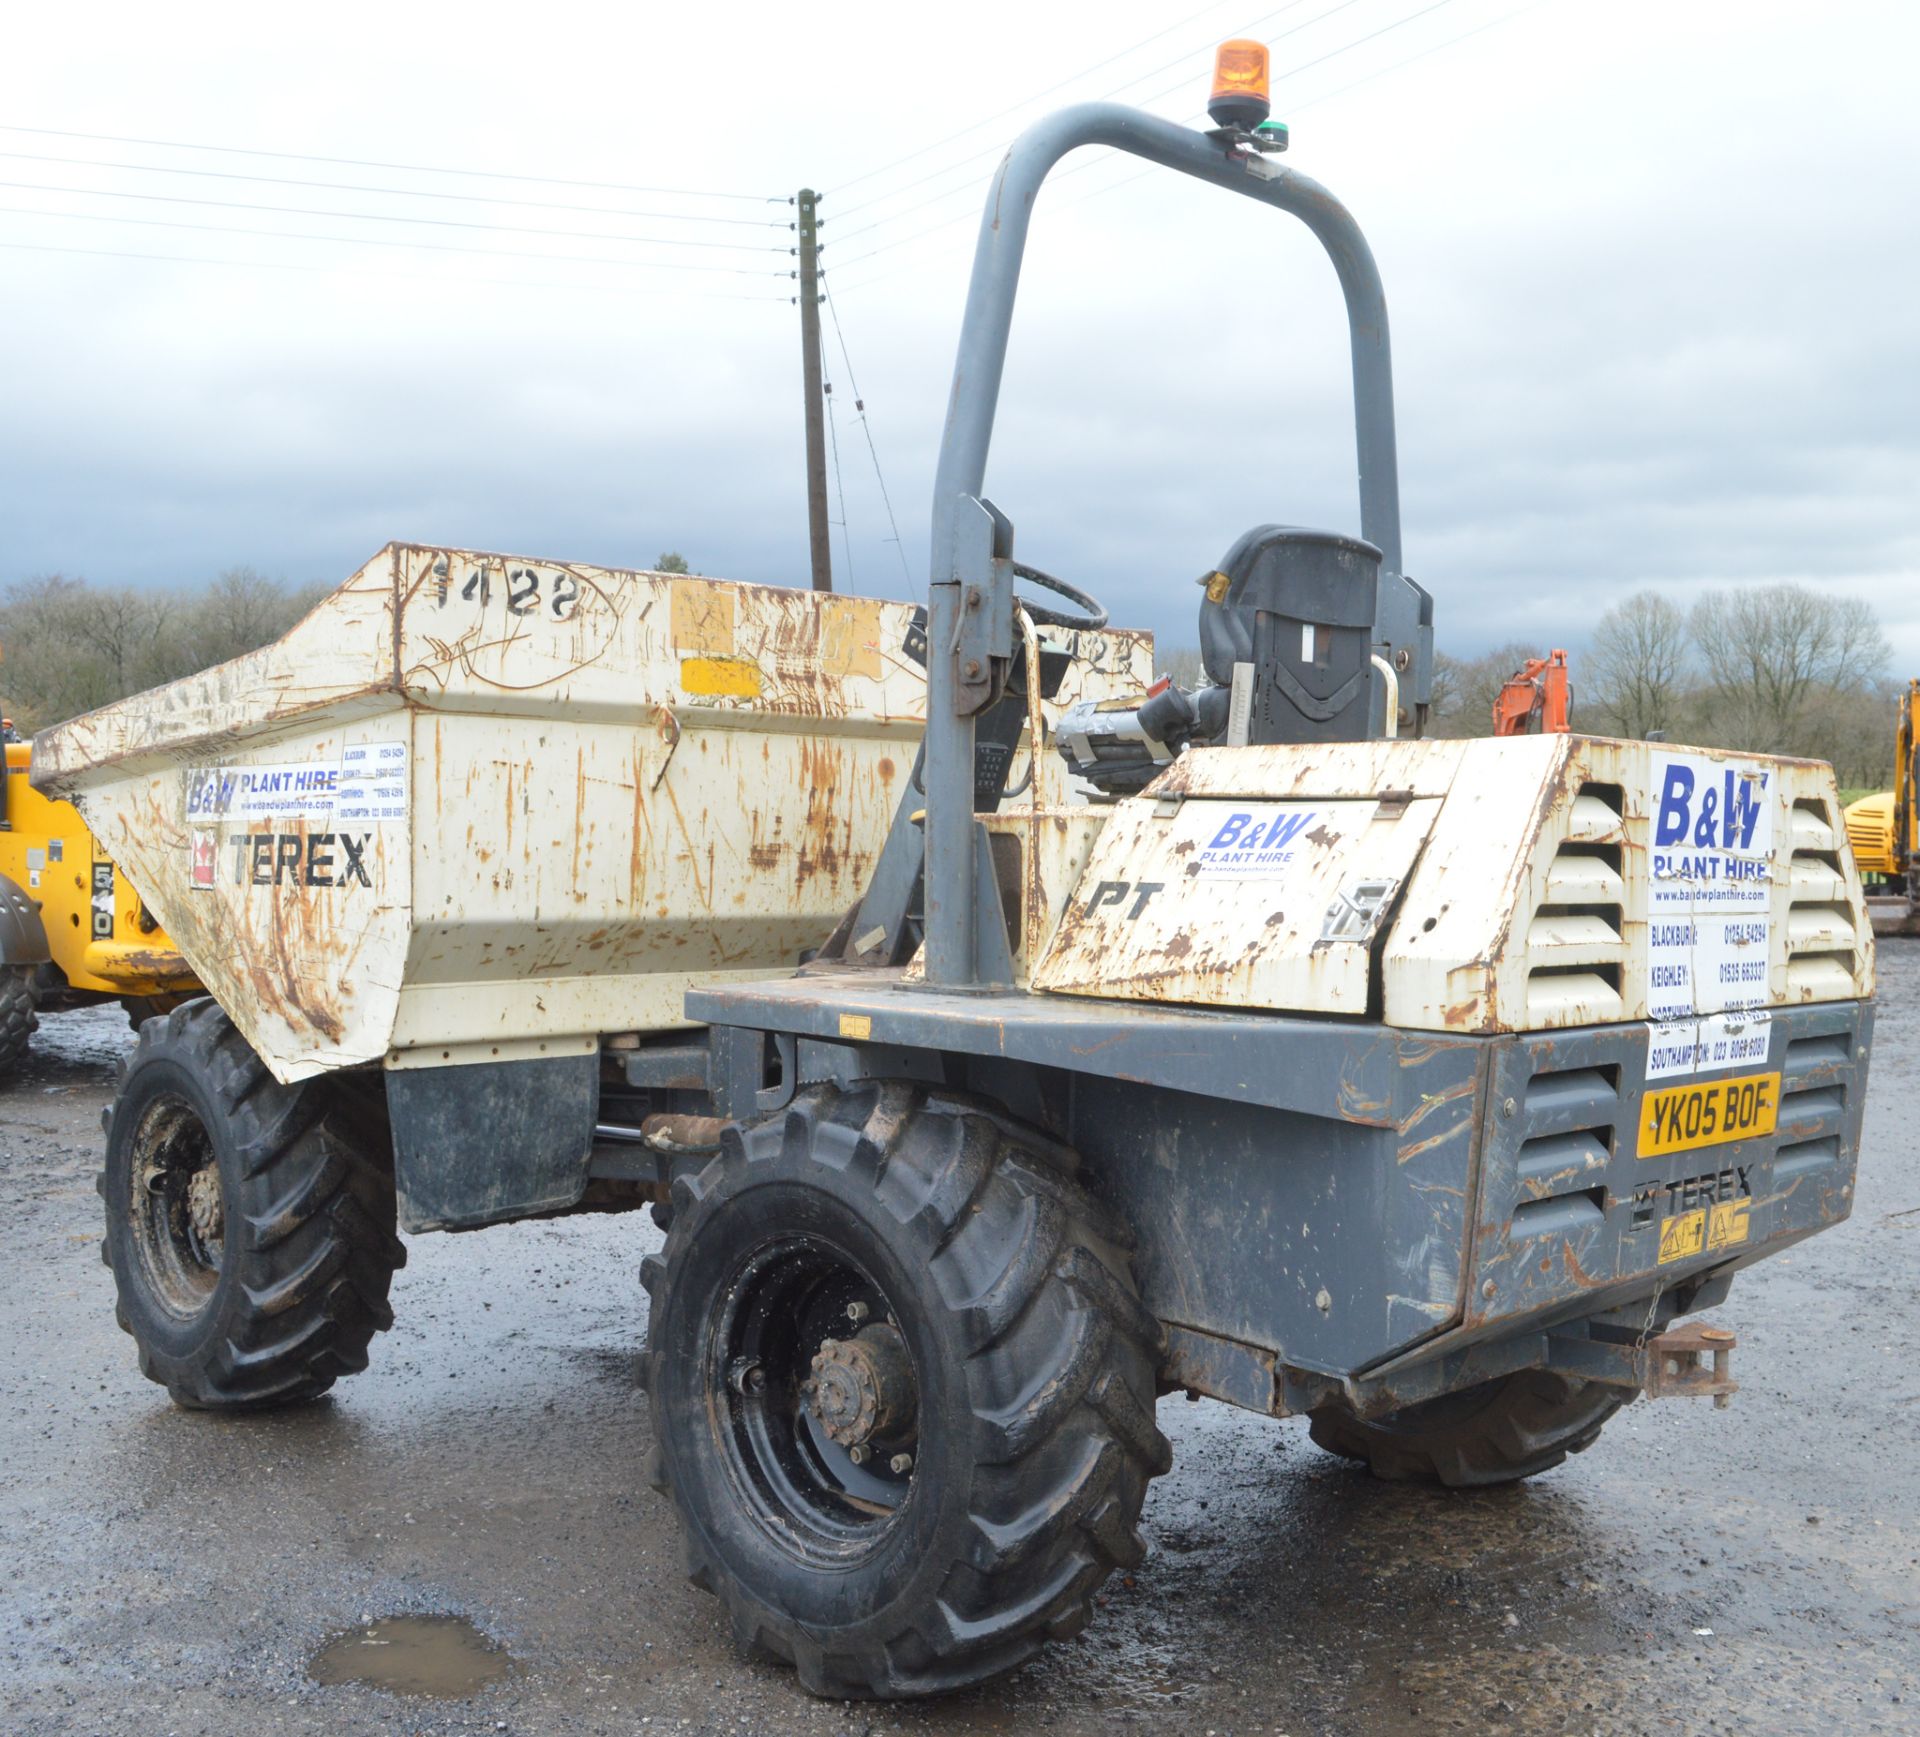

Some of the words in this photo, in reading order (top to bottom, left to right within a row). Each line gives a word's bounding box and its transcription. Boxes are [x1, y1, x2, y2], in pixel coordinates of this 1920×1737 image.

[188, 770, 238, 814] B&W
[241, 772, 293, 792] PLANT
[294, 770, 338, 790] HIRE
[1655, 764, 1768, 849] B&W
[1207, 812, 1317, 849] B&W
[230, 833, 372, 888] TEREX
[1200, 852, 1254, 863] PLANT
[1255, 852, 1294, 863] HIRE
[1654, 855, 1720, 880] PLANT
[1725, 858, 1767, 881] HIRE
[1083, 881, 1166, 920] PT
[1655, 889, 1765, 902] www.bandwplanthire.com
[1651, 965, 1688, 988] KEIGHLEY:
[1719, 962, 1740, 983] 01535
[1713, 1040, 1727, 1061] 023
[1654, 1089, 1719, 1145] YK05
[1723, 1080, 1770, 1132] BOF
[1663, 1163, 1754, 1215] TEREX
